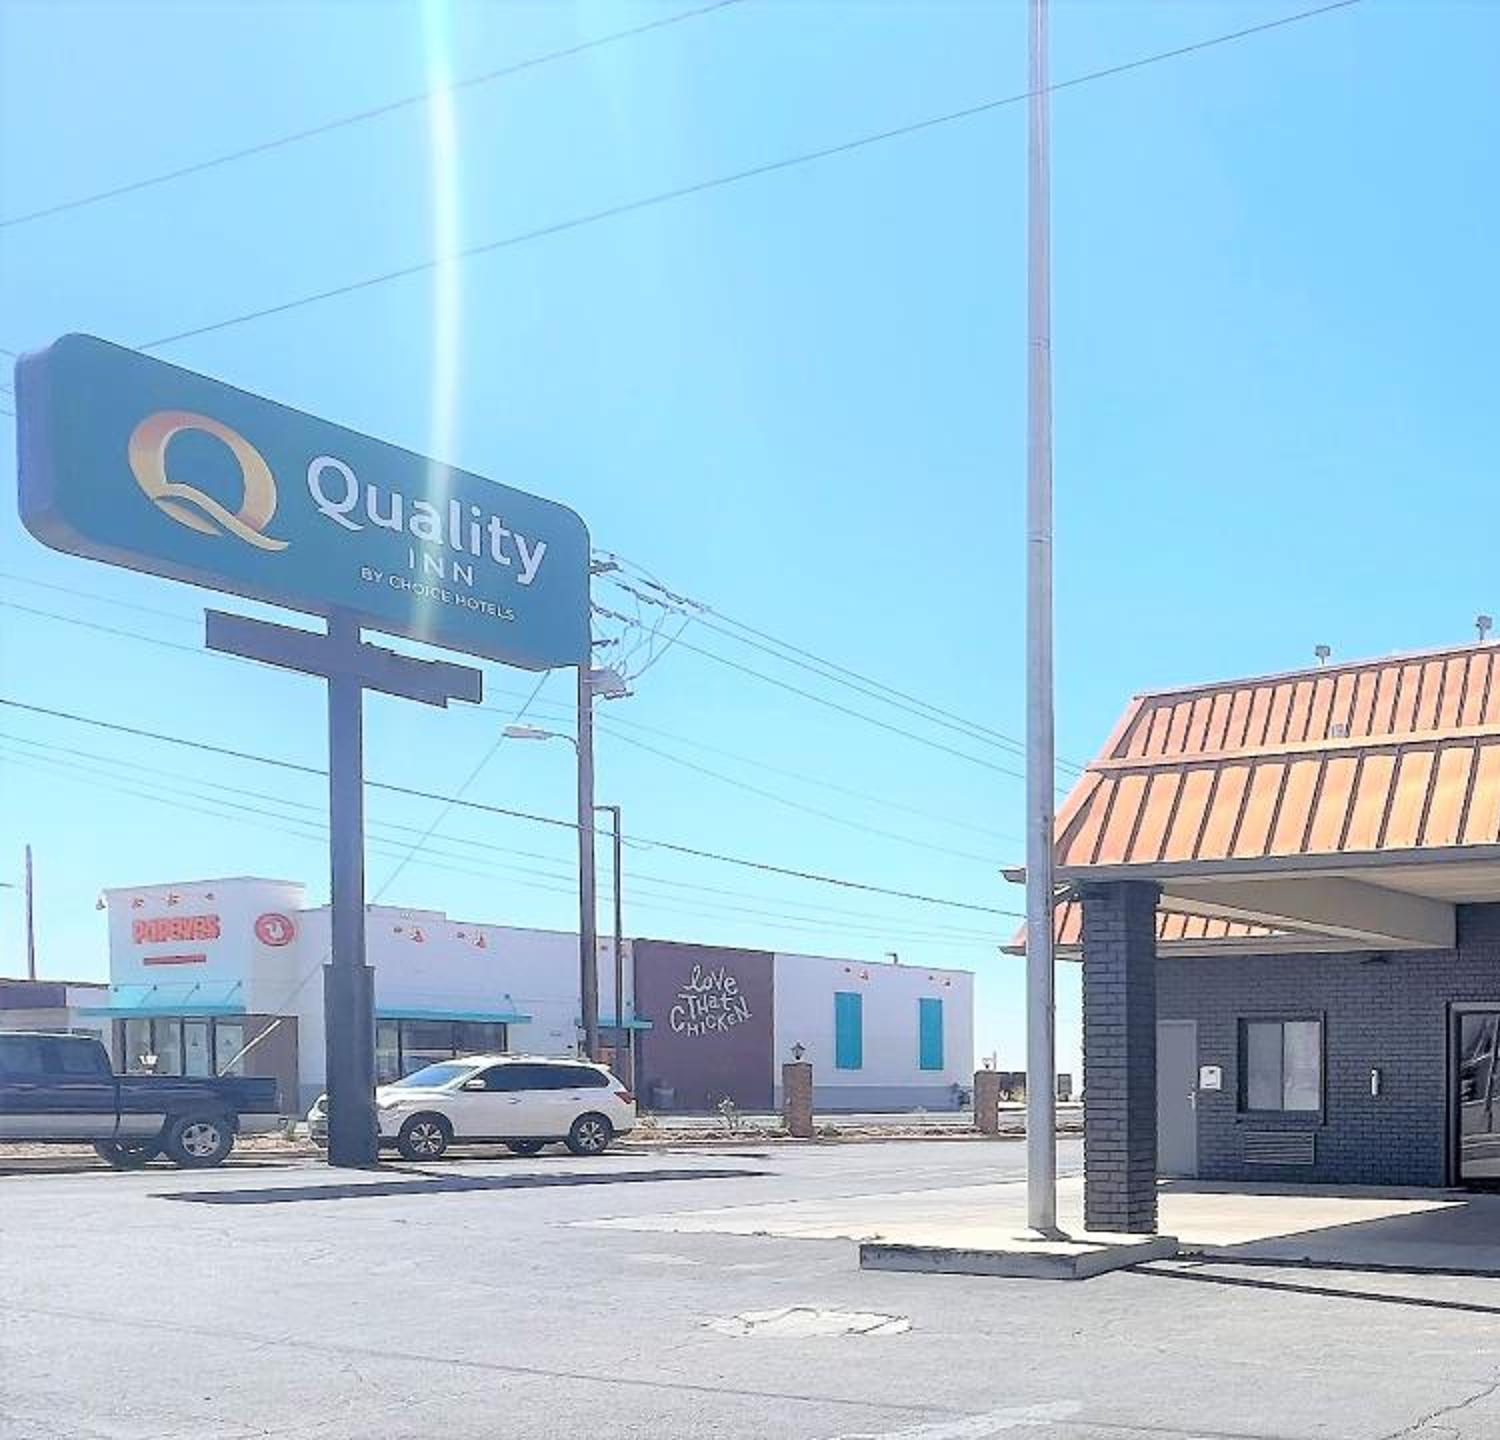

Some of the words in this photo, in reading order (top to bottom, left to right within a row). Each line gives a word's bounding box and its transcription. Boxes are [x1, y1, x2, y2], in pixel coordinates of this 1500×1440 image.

[307, 455, 547, 585] Quality
[361, 567, 384, 583] BY
[389, 575, 451, 603] CHOICE
[455, 593, 515, 621] HOTELS
[408, 547, 474, 587] INN
